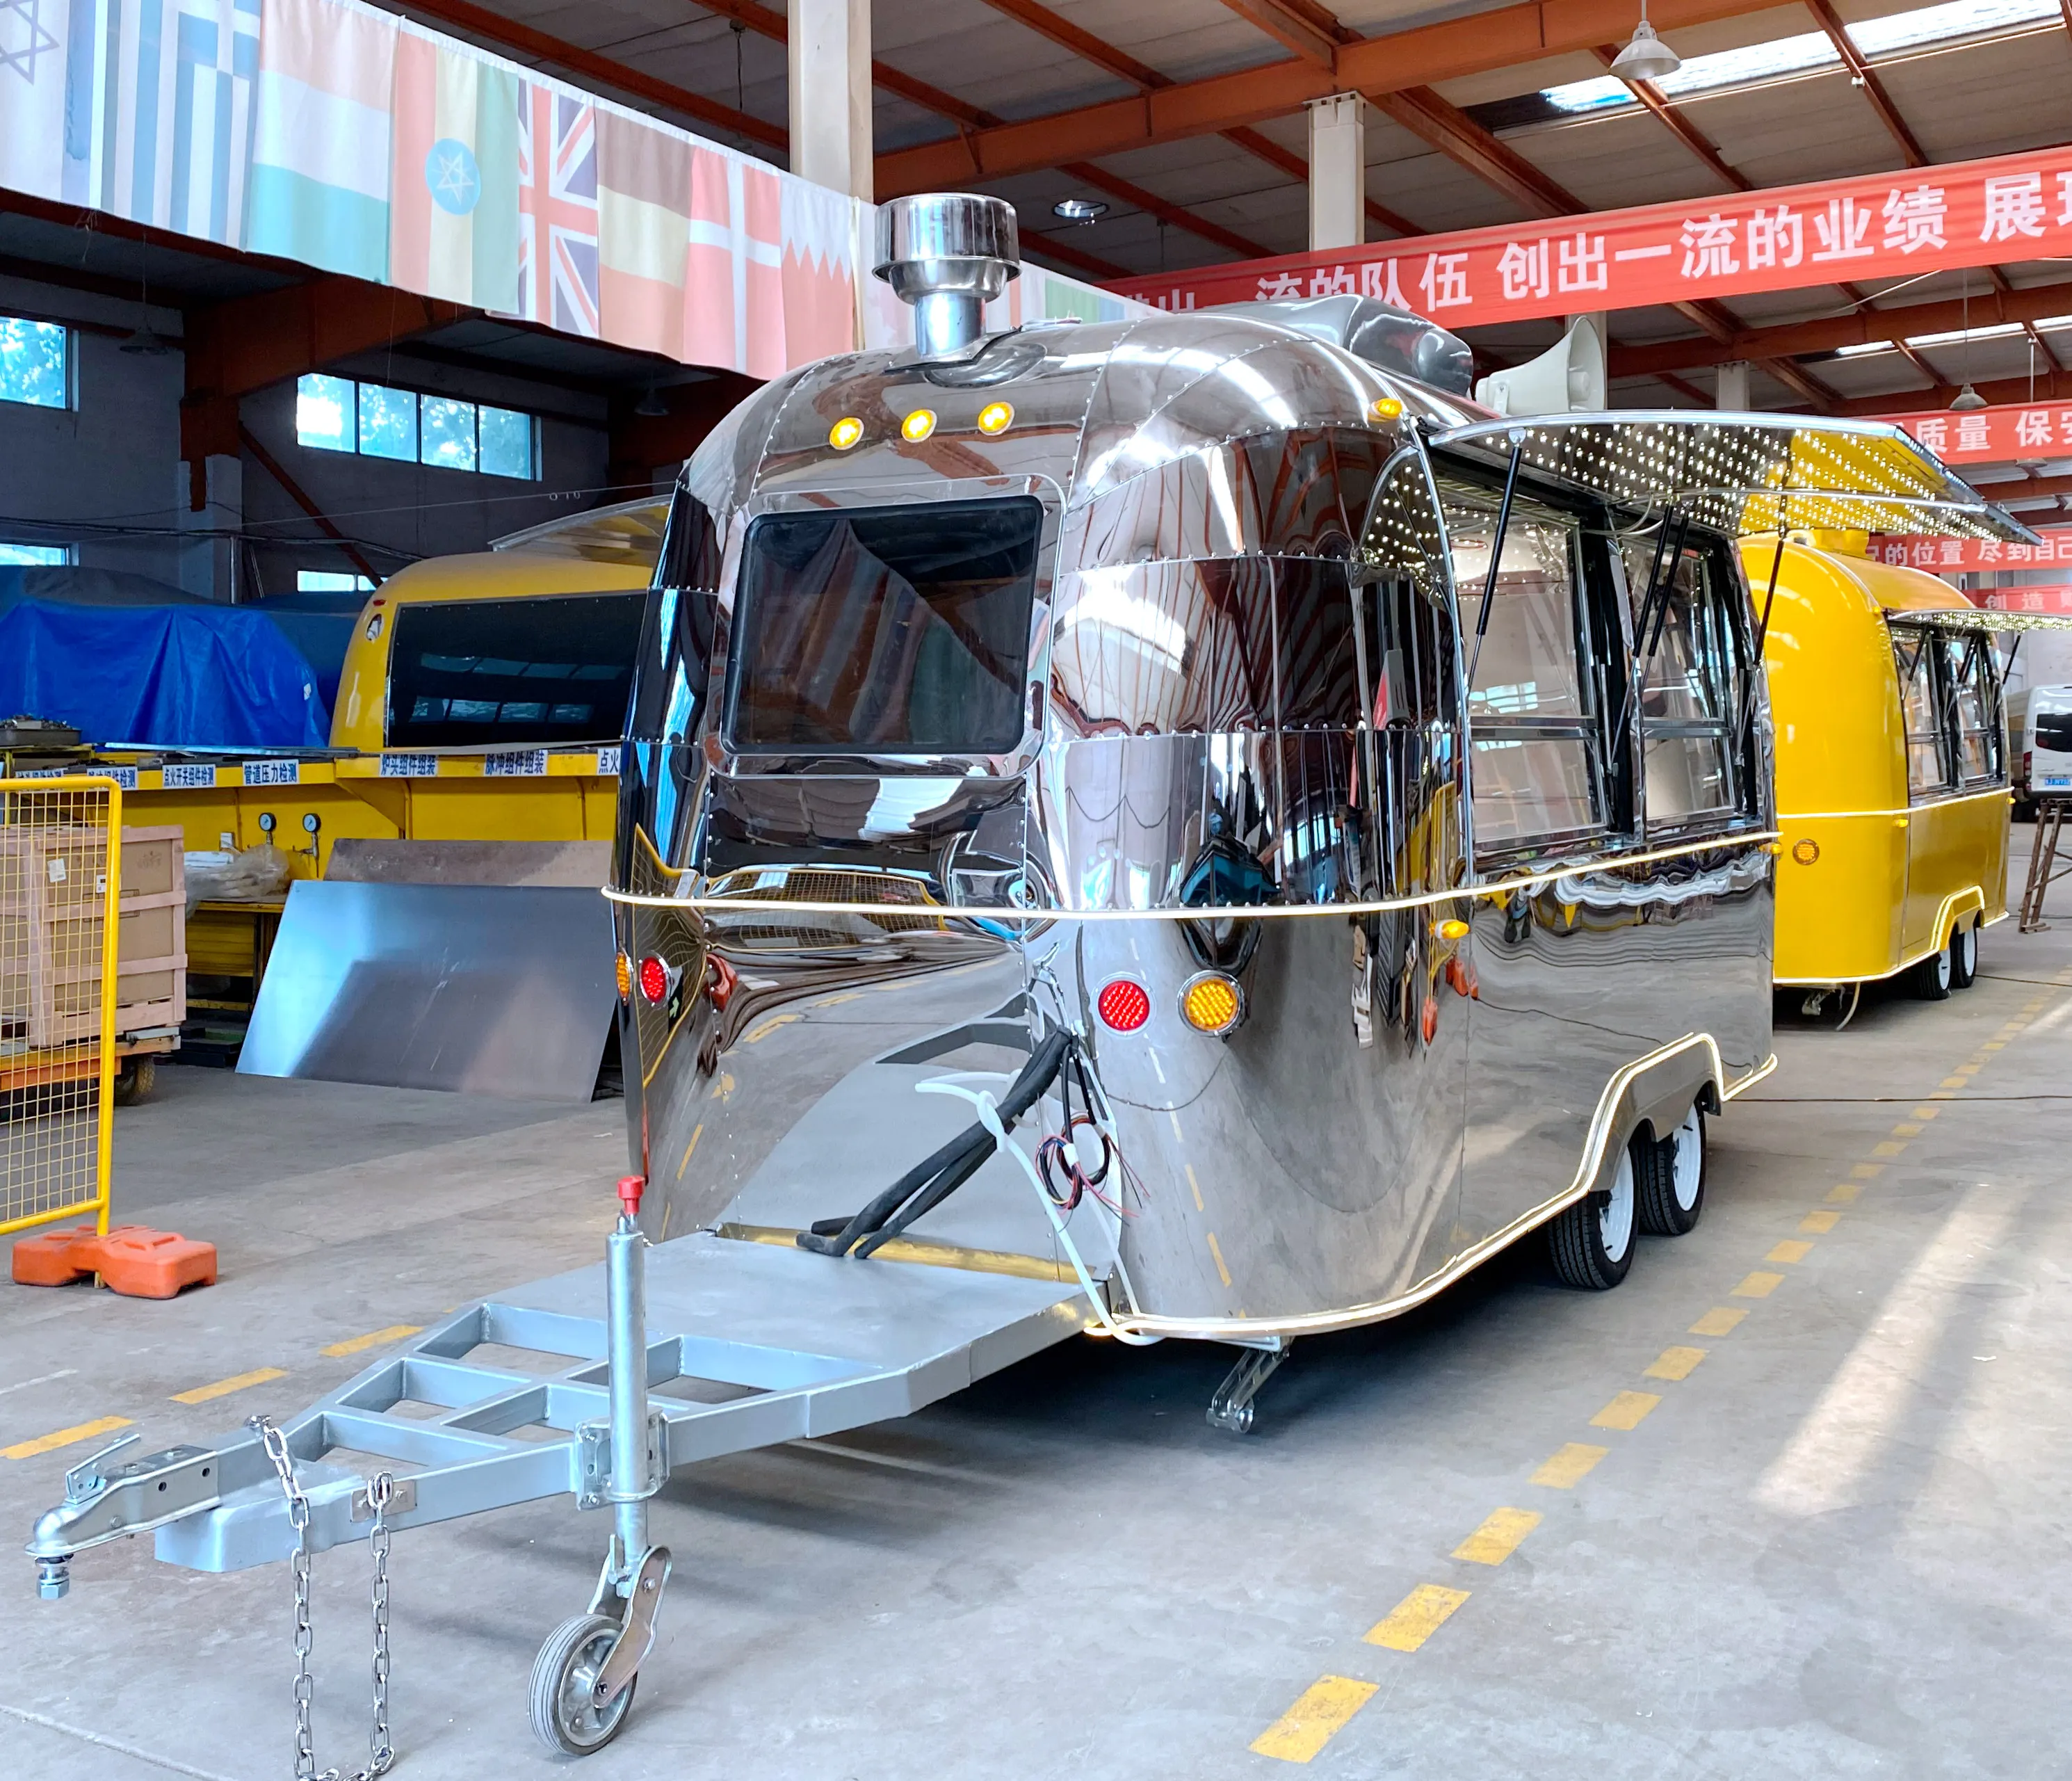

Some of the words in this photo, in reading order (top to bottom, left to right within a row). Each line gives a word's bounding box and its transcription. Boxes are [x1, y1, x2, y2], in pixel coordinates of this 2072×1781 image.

[1496, 184, 1948, 299] 创出一流的业绩
[1979, 170, 2072, 243] 展
[1899, 415, 1991, 453] 质量
[1977, 535, 2072, 563] 尽到自己
[164, 766, 214, 787] 点火开关组件检测
[244, 762, 297, 785] 管道压力检测
